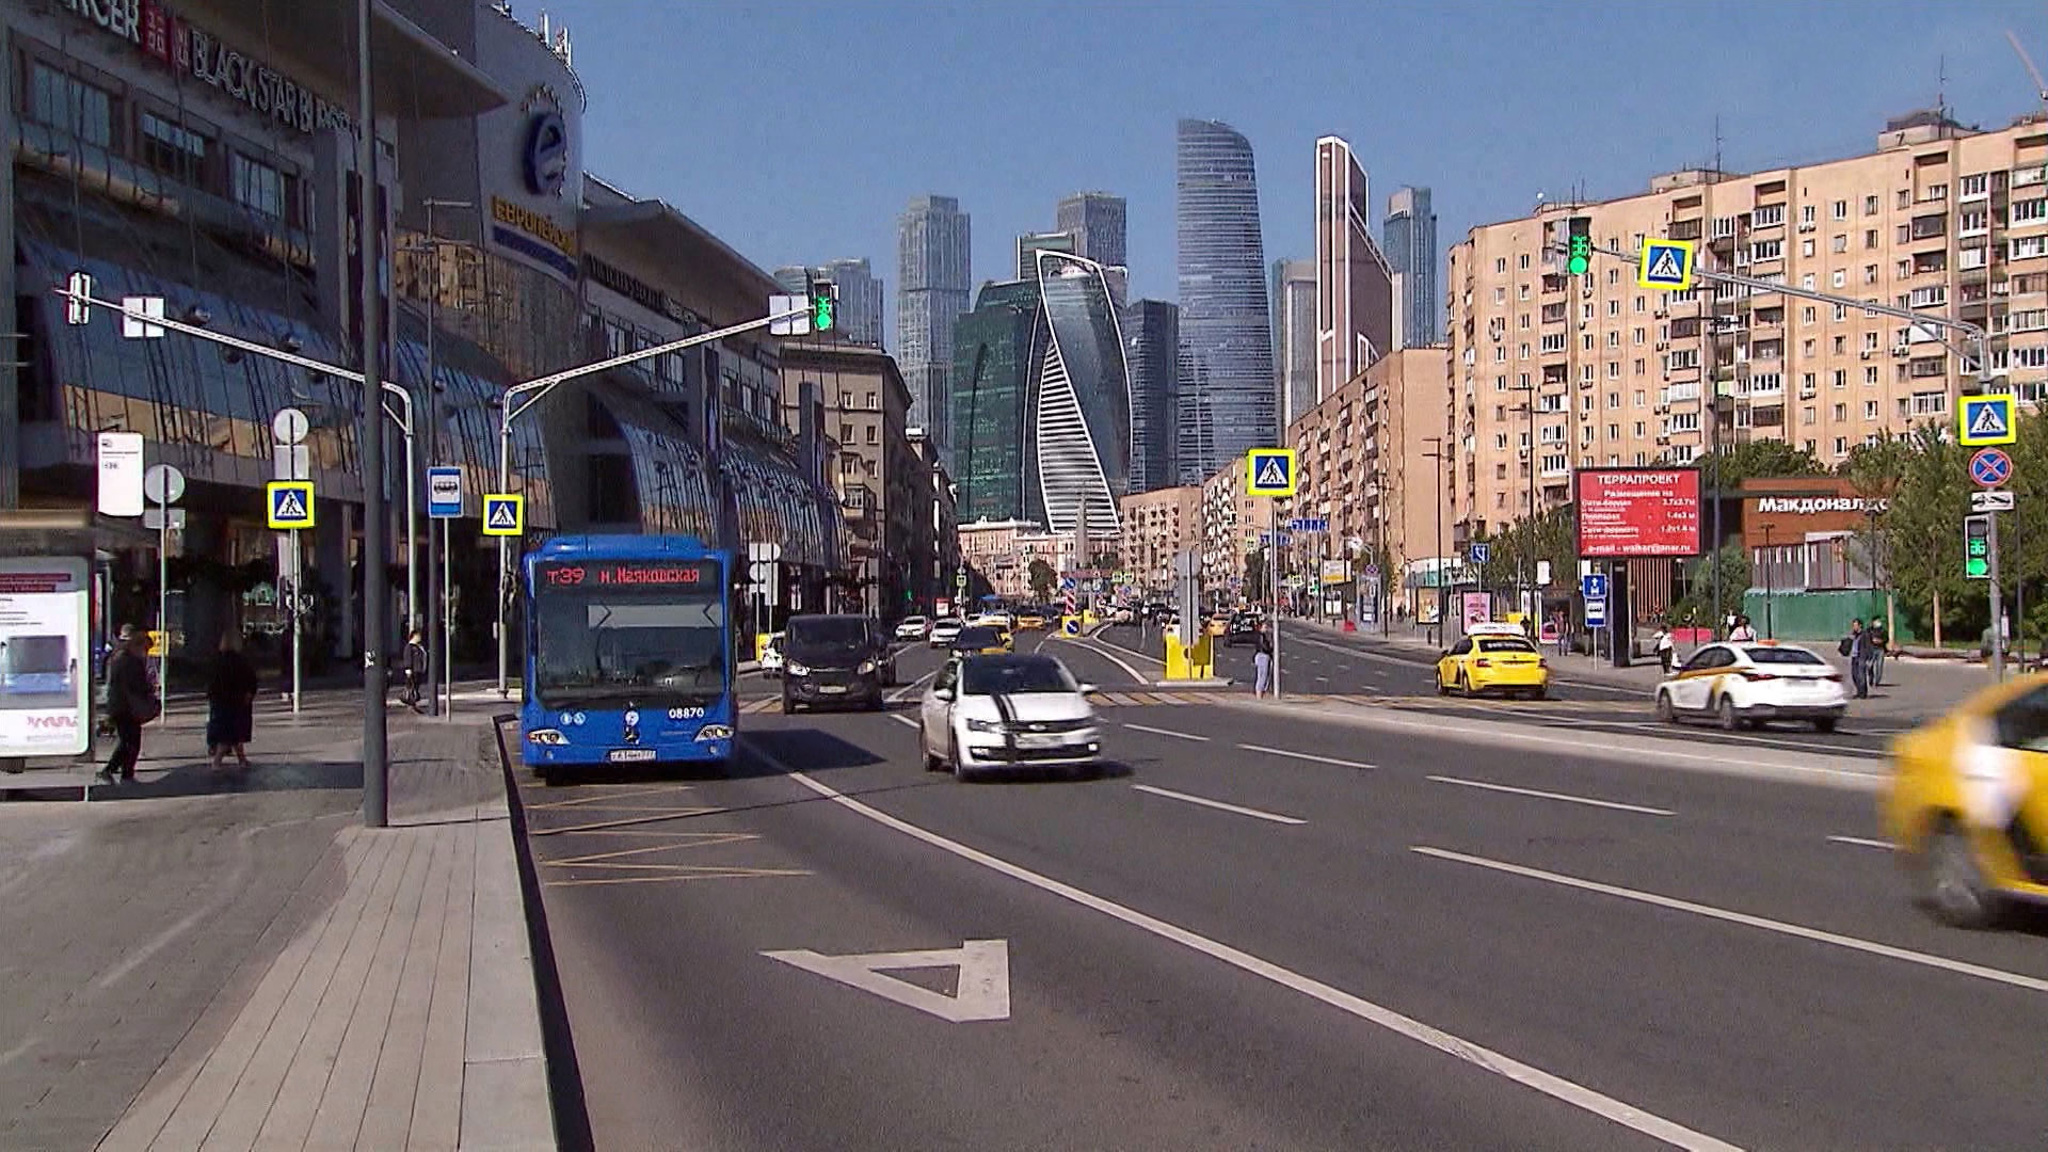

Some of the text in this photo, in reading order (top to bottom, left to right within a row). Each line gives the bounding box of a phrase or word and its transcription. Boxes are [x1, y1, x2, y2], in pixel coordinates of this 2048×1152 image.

[192, 29, 257, 110] BLACK
[258, 66, 298, 130] STAR
[1598, 474, 1680, 484] ТЕРРАПРОЕКТ
[668, 707, 705, 719] 08870
